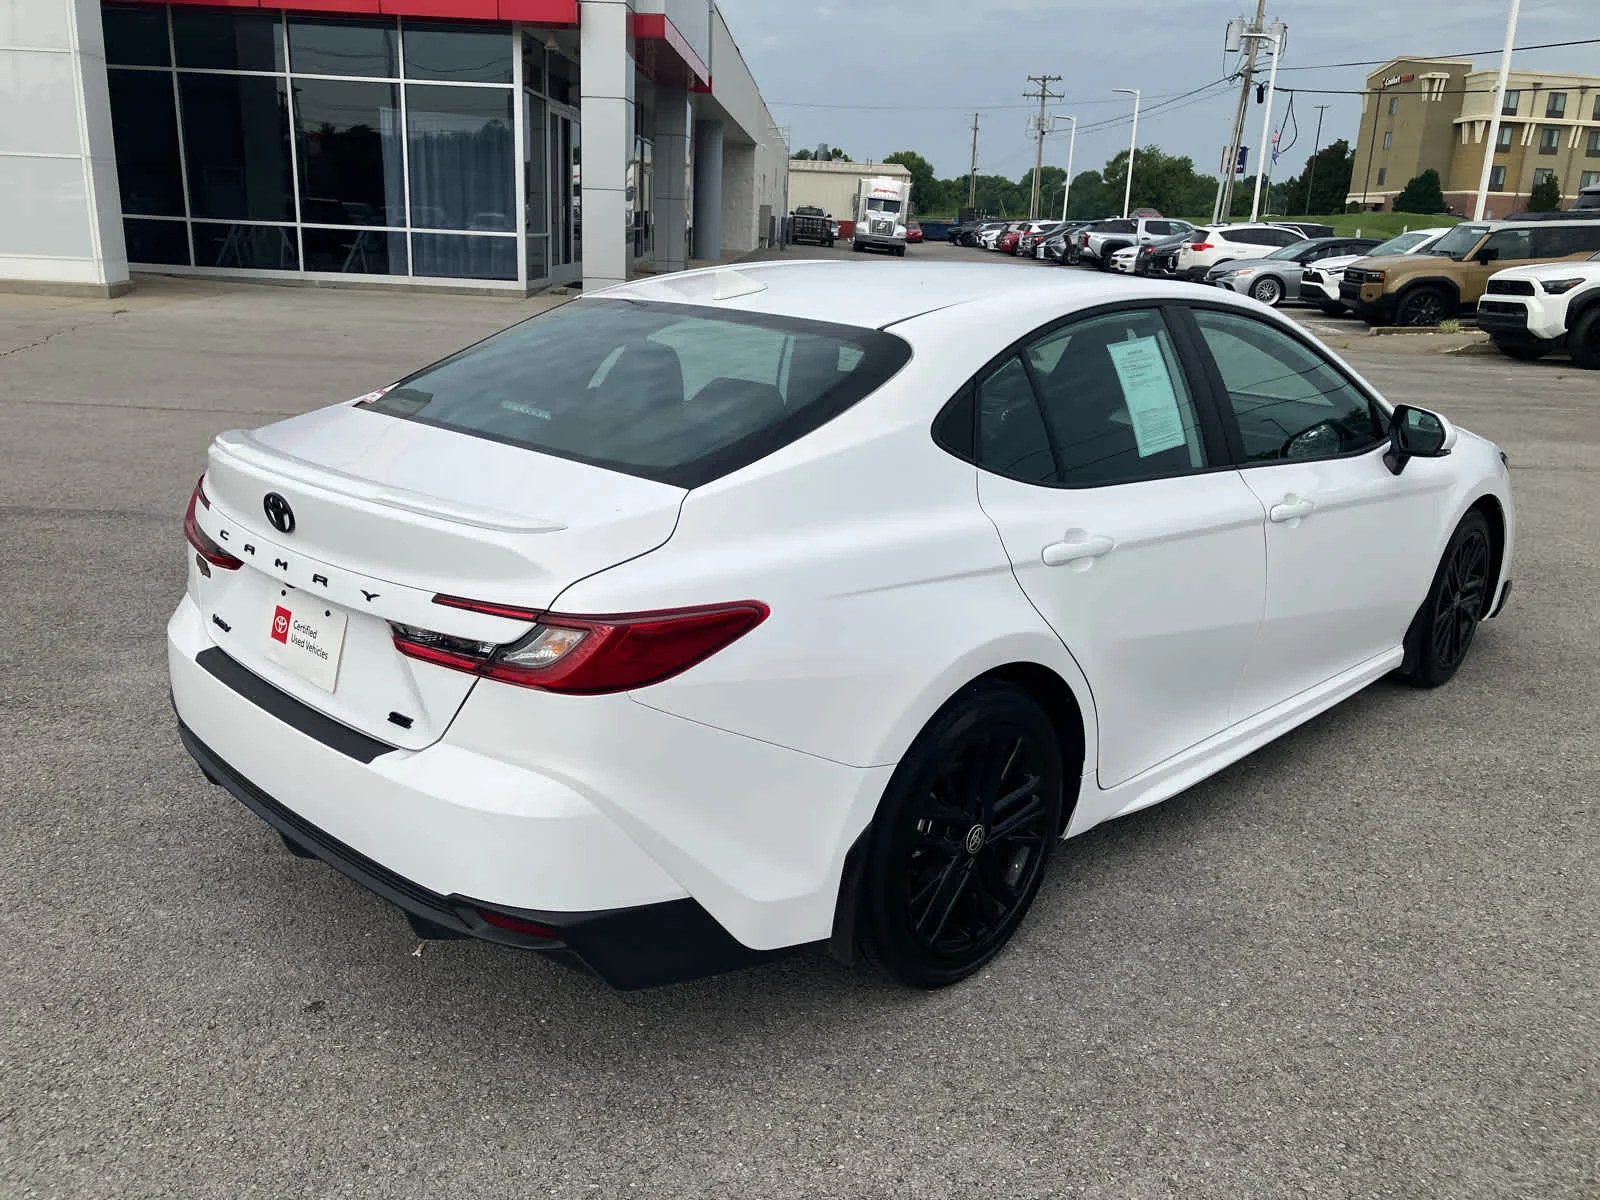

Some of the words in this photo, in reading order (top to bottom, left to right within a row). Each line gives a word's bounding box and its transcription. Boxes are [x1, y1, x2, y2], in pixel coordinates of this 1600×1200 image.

[219, 529, 381, 602] CAMRY
[293, 619, 318, 639] Certified
[291, 632, 306, 648] Used
[305, 640, 329, 660] Vehicles
